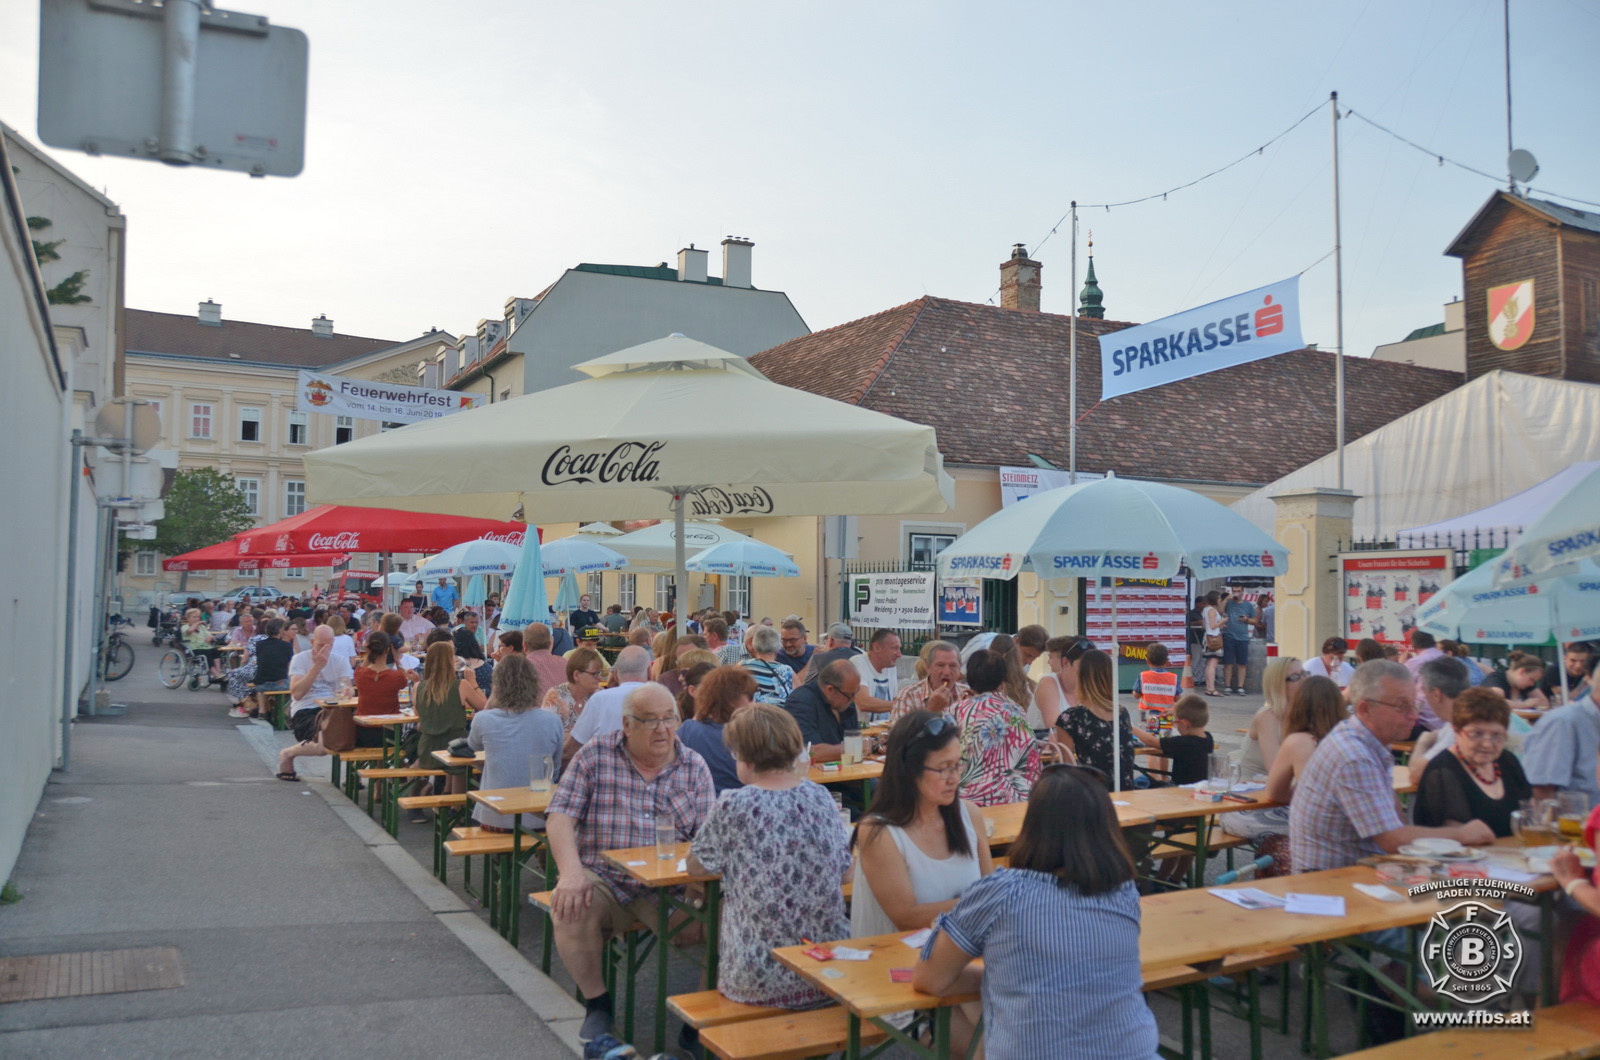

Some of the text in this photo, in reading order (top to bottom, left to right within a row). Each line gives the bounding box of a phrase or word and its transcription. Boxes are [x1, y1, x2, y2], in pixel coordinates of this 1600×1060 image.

[1112, 312, 1252, 376] SPARKASSE
[340, 381, 451, 407] Feuerwehrfest
[367, 404, 378, 412] 14.
[379, 405, 391, 413] bis
[395, 407, 404, 415] 16.
[407, 409, 423, 417] Juni
[423, 410, 443, 418] 2019
[541, 440, 668, 486] Coca-Cola
[1002, 472, 1038, 484] STEINMETZ
[308, 532, 360, 550] Coca-Cola
[469, 564, 500, 572] SPARKASSE
[950, 556, 1002, 570] SPARKASSE
[1053, 555, 1141, 569] SPARKASSE
[1201, 553, 1261, 569] SPARKASSE
[346, 571, 380, 579] FEUERWEHR
[884, 576, 926, 587] montageservice
[1473, 586, 1527, 602] SPARKASSE
[1125, 645, 1148, 660] DANK
